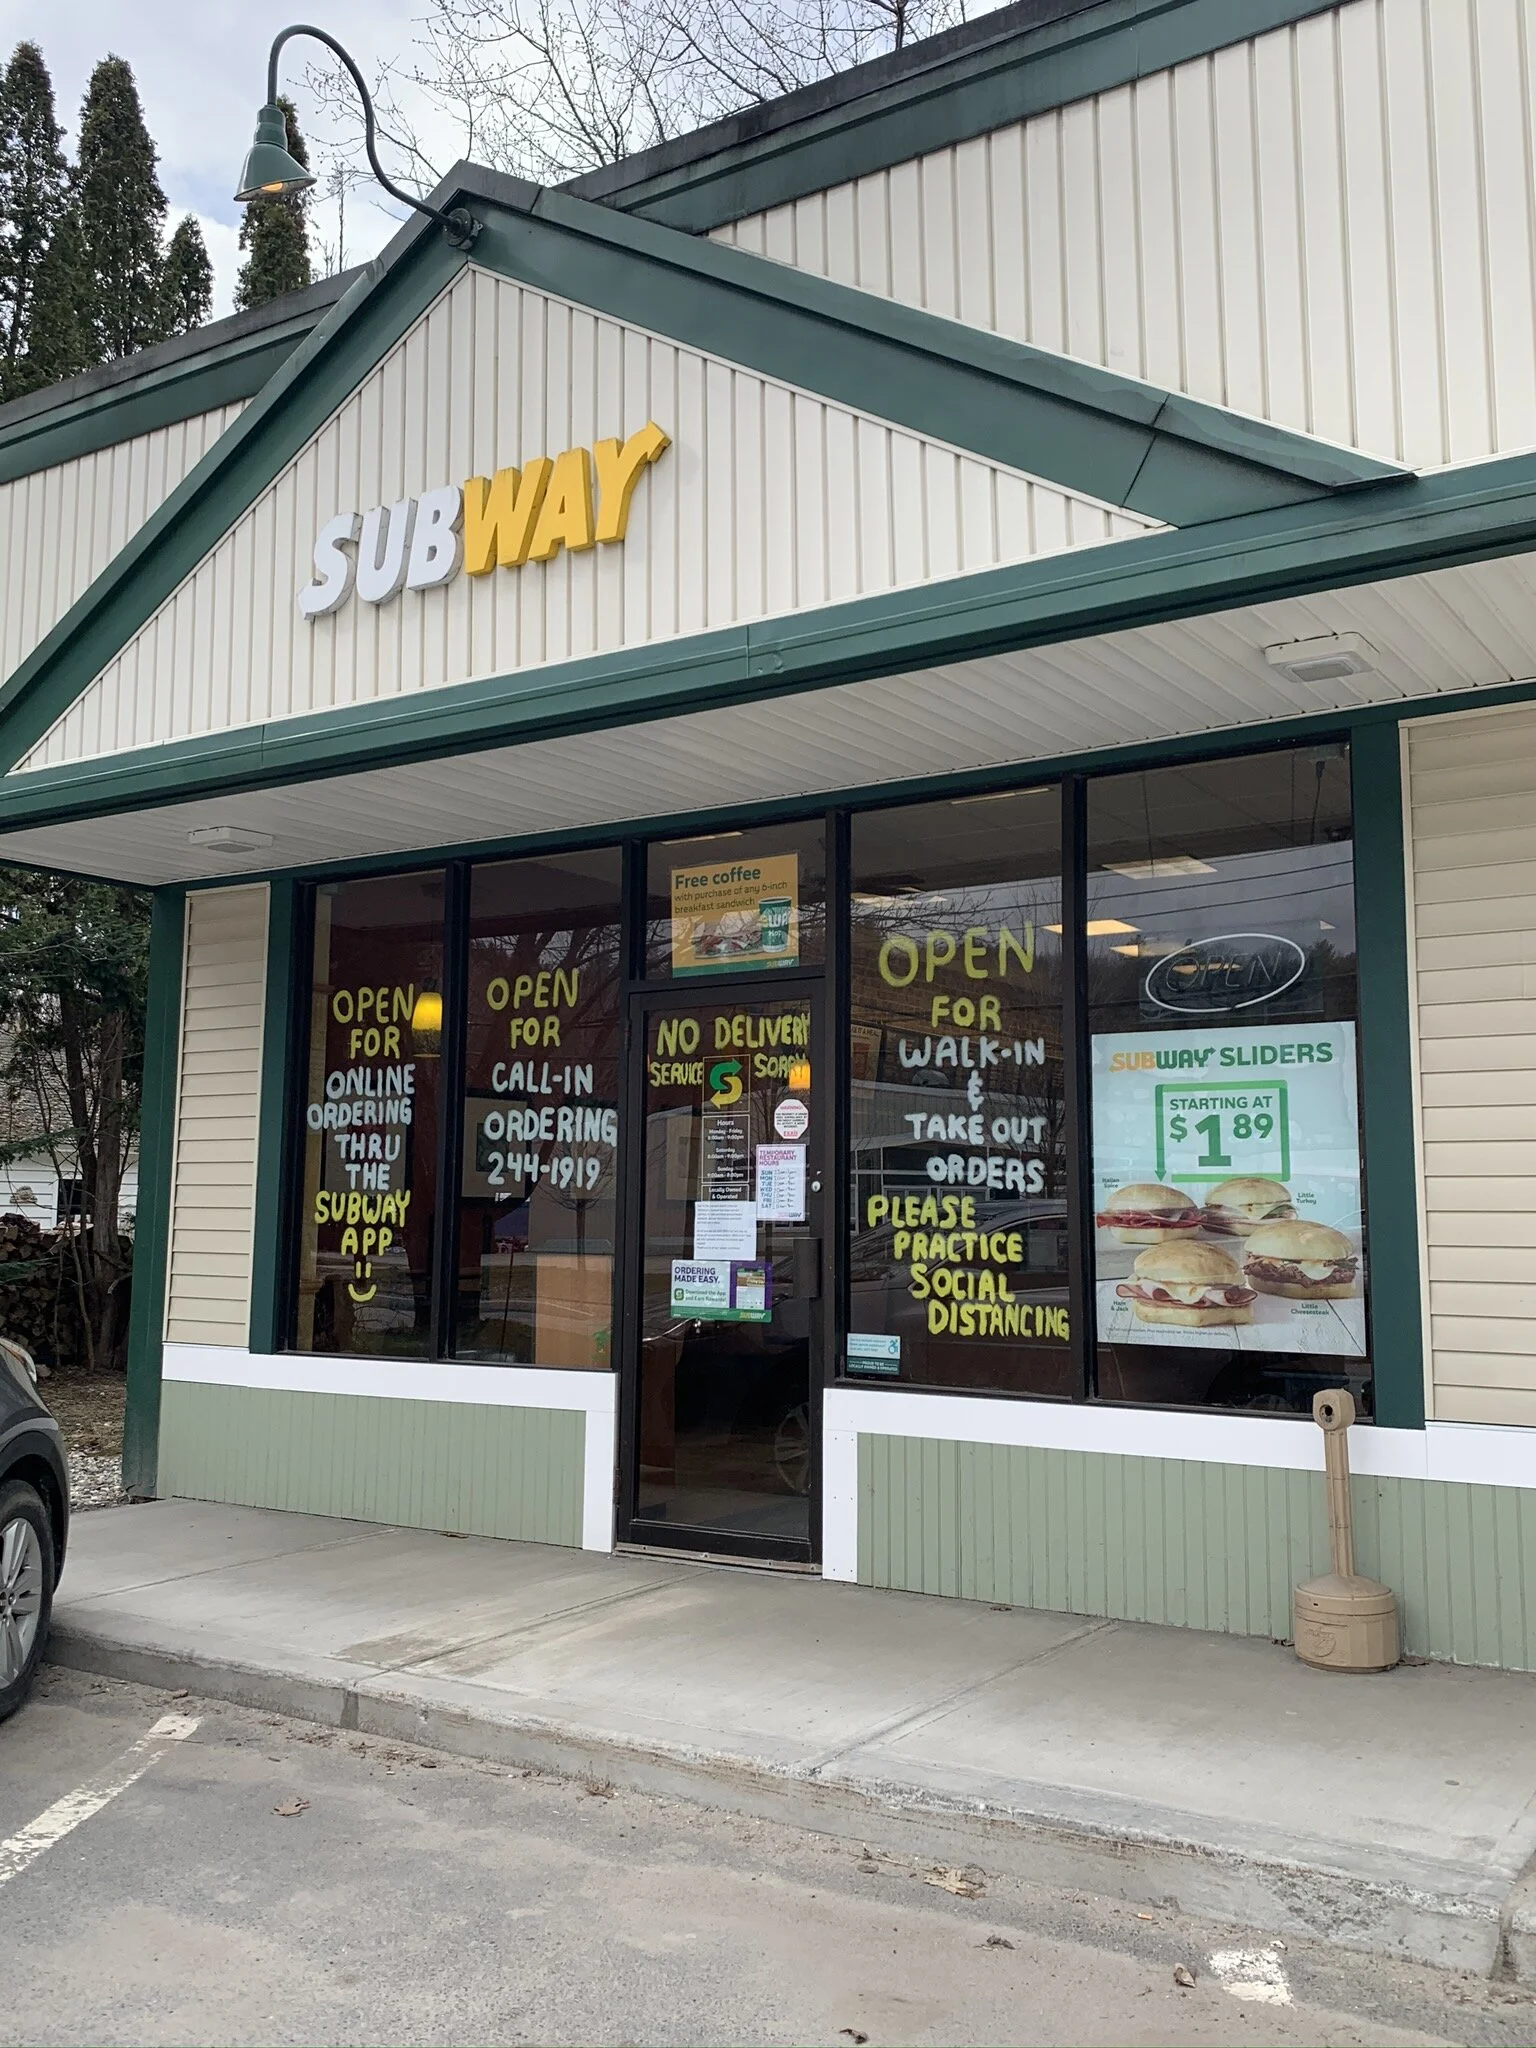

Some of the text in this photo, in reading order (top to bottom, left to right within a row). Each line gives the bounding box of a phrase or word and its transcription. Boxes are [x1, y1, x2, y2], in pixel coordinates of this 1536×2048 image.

[298, 420, 672, 621] SUBWAY
[674, 881, 788, 902] with purchase of any 6-inch
[675, 866, 761, 889] Free coffee
[674, 898, 755, 914] breakfast sandwich
[878, 920, 1035, 988] OPEN
[1164, 951, 1282, 992] OPEN
[333, 984, 414, 1023] OPEN
[486, 968, 580, 1010] OPEN
[931, 994, 1002, 1032] FOR
[350, 1026, 400, 1060] FOR
[510, 1015, 561, 1049] FOR
[657, 1012, 811, 1057] NO DELIVERY
[899, 1035, 1045, 1069] WALK-IN
[1108, 1042, 1333, 1073] SUBWAY SLIDERS
[326, 1064, 415, 1099] ONLINE
[492, 1060, 593, 1096] CALL-IN
[650, 1061, 704, 1087] SERVICE
[307, 1098, 412, 1130] ORDERING
[1169, 1096, 1273, 1111] STARTING AT
[484, 1106, 618, 1147] ORDERING
[904, 1112, 1048, 1145] TAKE OUT
[334, 1133, 400, 1161] THRU
[345, 1162, 390, 1191] THE
[487, 1151, 601, 1190] 244-1919
[926, 1153, 1045, 1193] ORDERS
[314, 1189, 411, 1227] SUBWAY
[867, 1194, 976, 1229] PLEASE
[341, 1227, 393, 1256] APP
[893, 1230, 1024, 1263] PRACTICE
[674, 1267, 716, 1275] ORDERING
[674, 1275, 721, 1284] MADE EASY.
[910, 1262, 1016, 1303] SOCIAL
[927, 1299, 1070, 1342] DISTANCING
[1290, 1308, 1330, 1316] Cheesesteak
